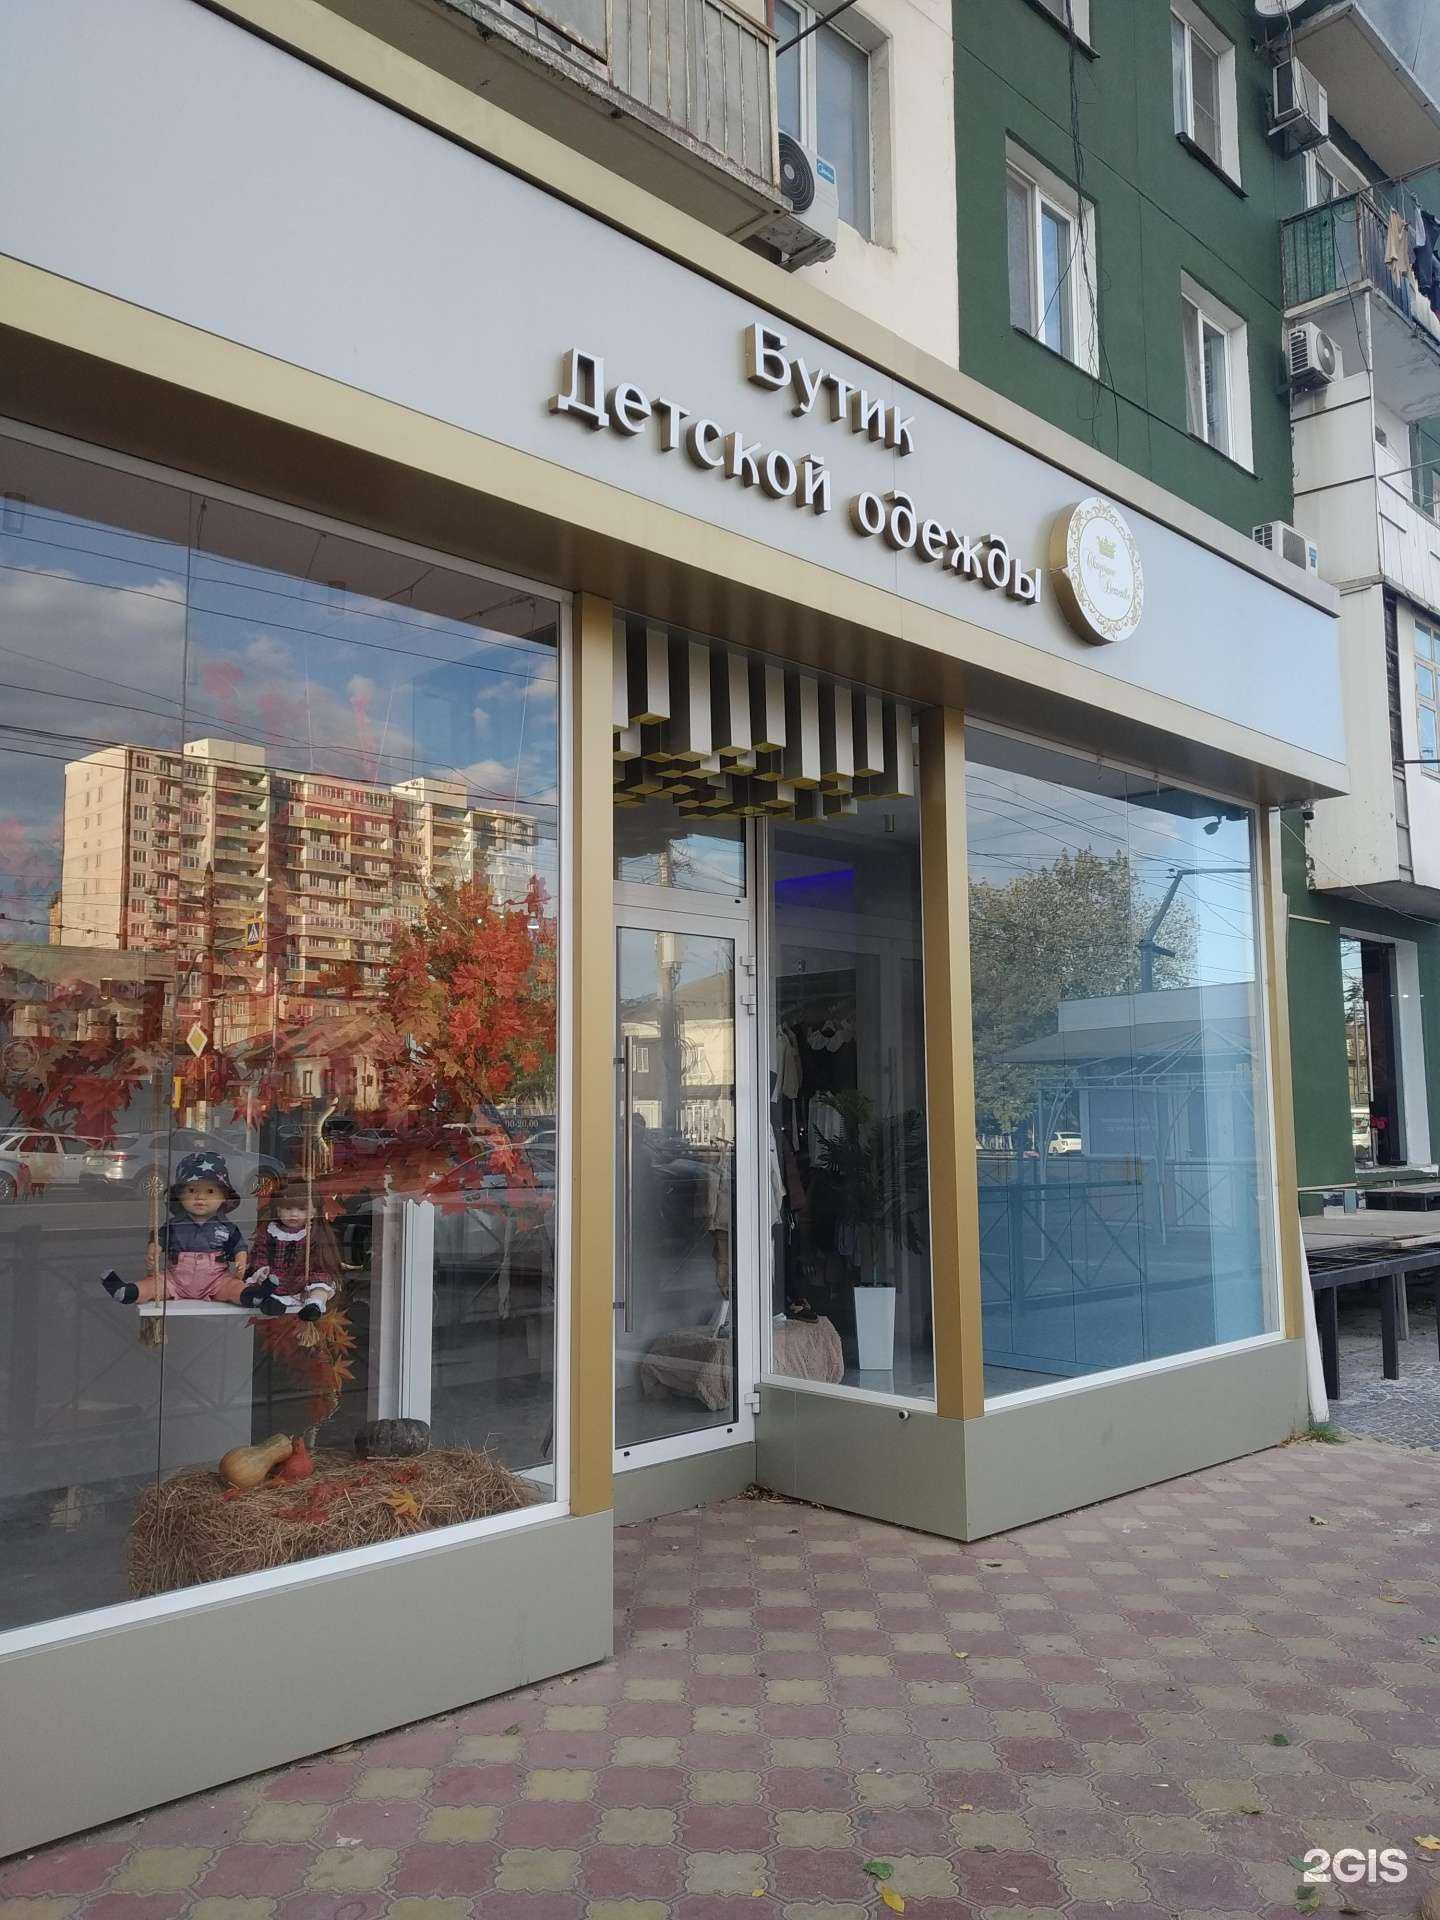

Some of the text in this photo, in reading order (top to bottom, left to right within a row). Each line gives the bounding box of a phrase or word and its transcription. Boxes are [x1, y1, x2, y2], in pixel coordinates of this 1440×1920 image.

[550, 347, 1042, 604] Детской одежды
[747, 322, 915, 456] Бутик
